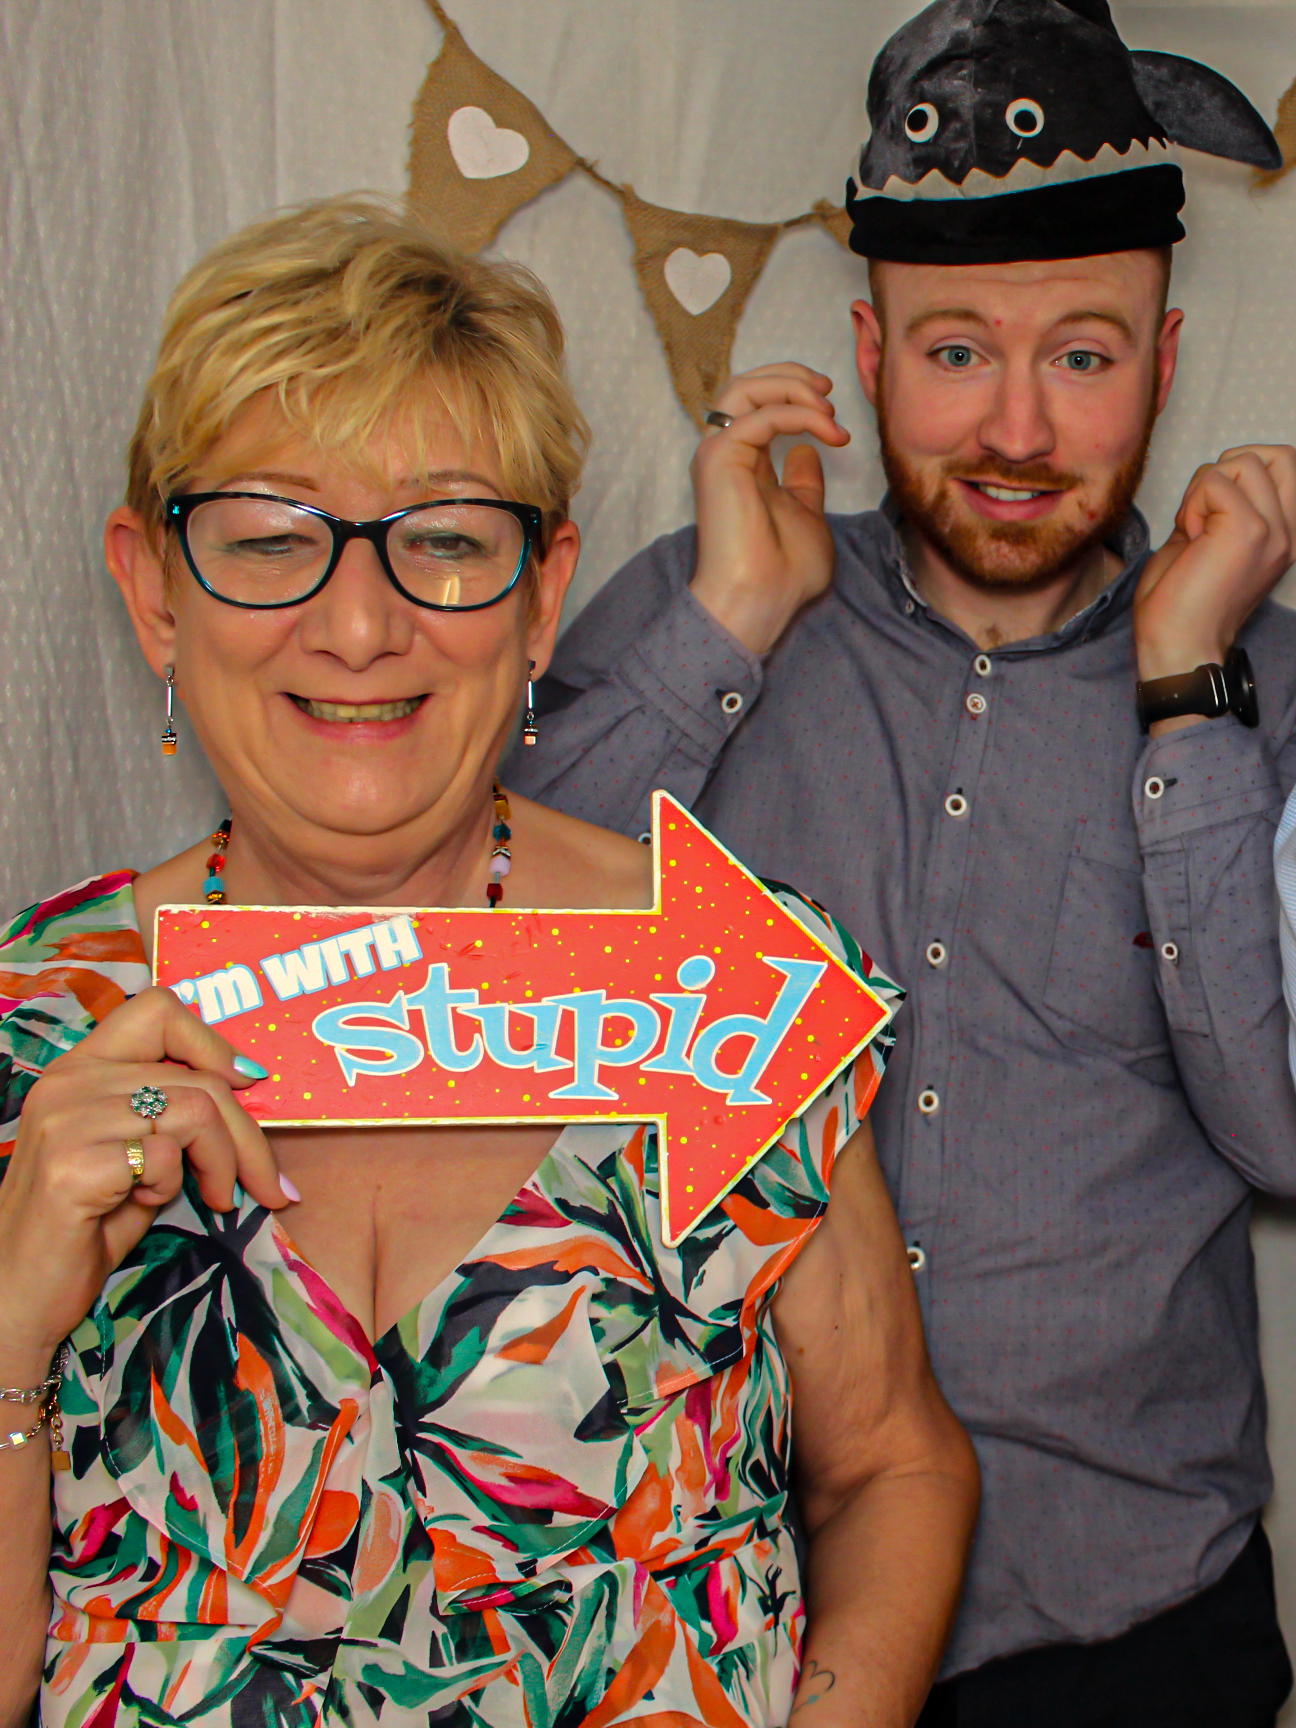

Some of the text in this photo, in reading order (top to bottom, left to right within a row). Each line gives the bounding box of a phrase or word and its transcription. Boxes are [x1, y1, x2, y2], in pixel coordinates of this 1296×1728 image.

[169, 914, 423, 1025] 'm WITH
[312, 954, 829, 1106] stupid
